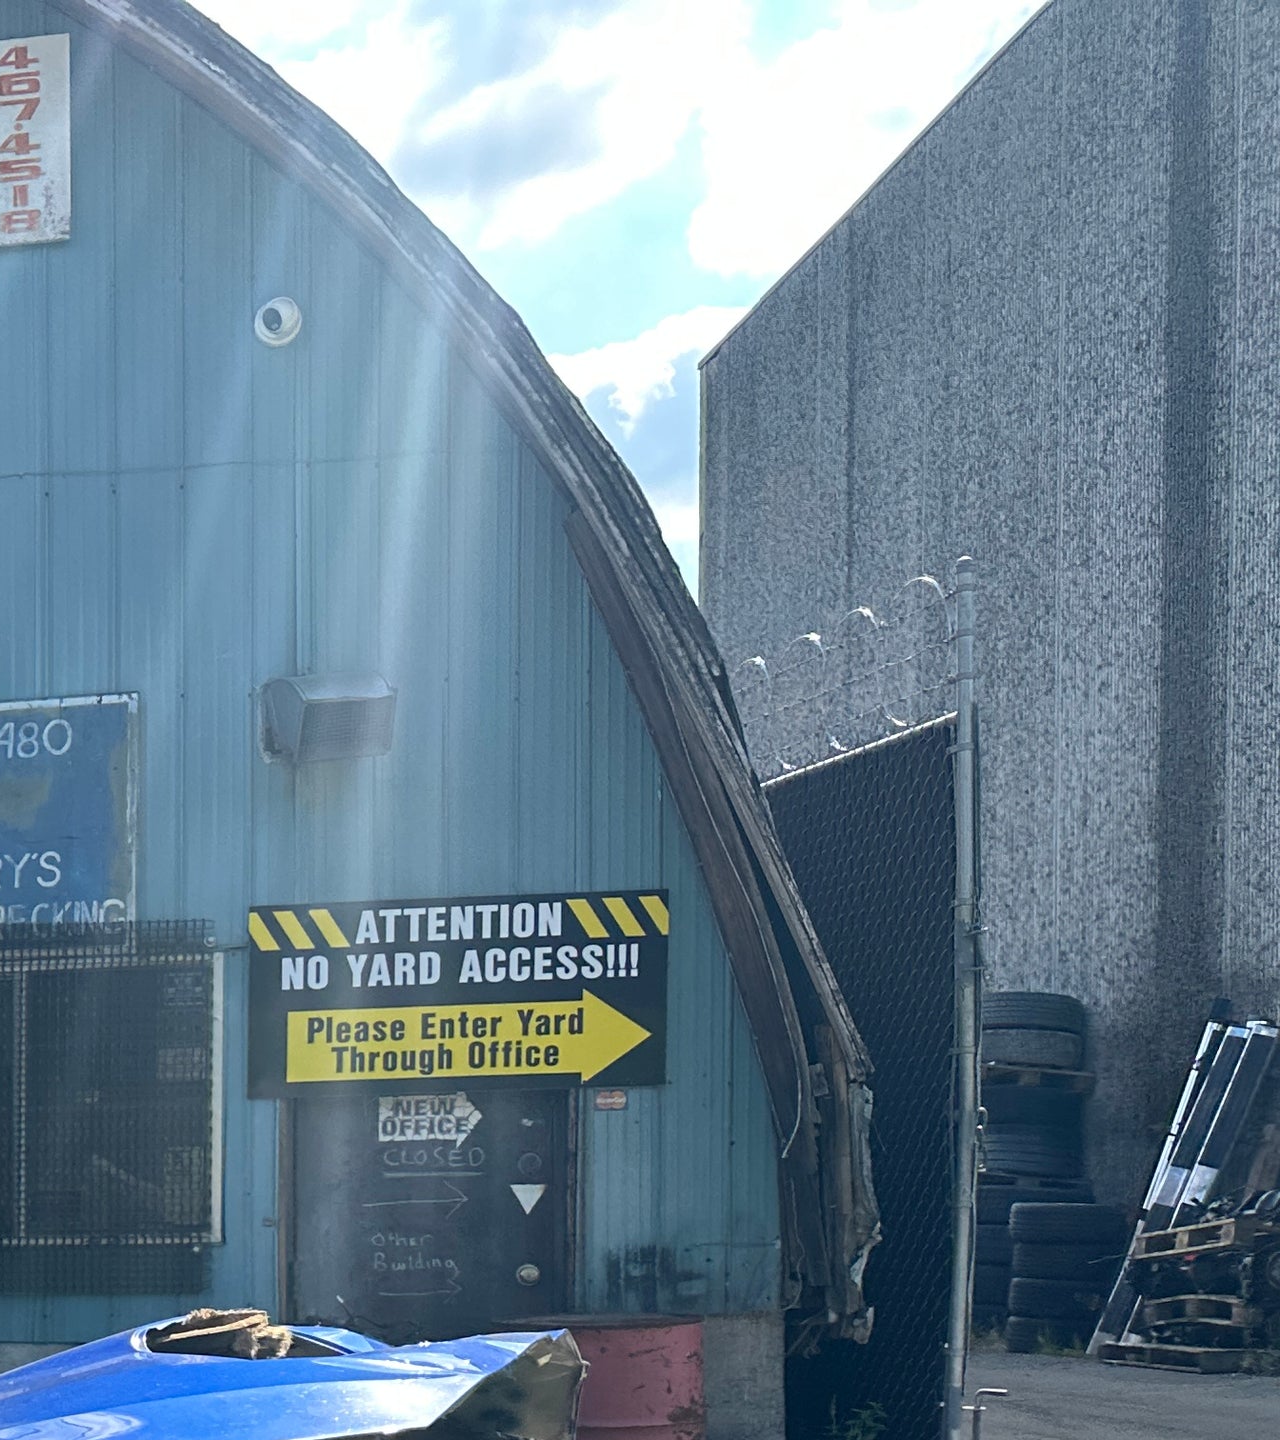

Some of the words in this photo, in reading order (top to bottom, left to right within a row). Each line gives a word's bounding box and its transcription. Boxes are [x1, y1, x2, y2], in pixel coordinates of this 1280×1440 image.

[354, 901, 563, 945] ATTENTION
[280, 954, 330, 991] NO
[346, 950, 441, 988] YARD
[458, 942, 640, 984] ACCESS!!!
[306, 1014, 406, 1045] Please
[420, 1011, 503, 1040] Enter
[516, 1007, 585, 1037] Yard
[330, 1043, 454, 1076] Through
[468, 1040, 561, 1070] Office
[392, 1097, 454, 1117] NEW
[381, 1115, 469, 1137] OFFICE
[383, 1147, 485, 1167] CLOSED
